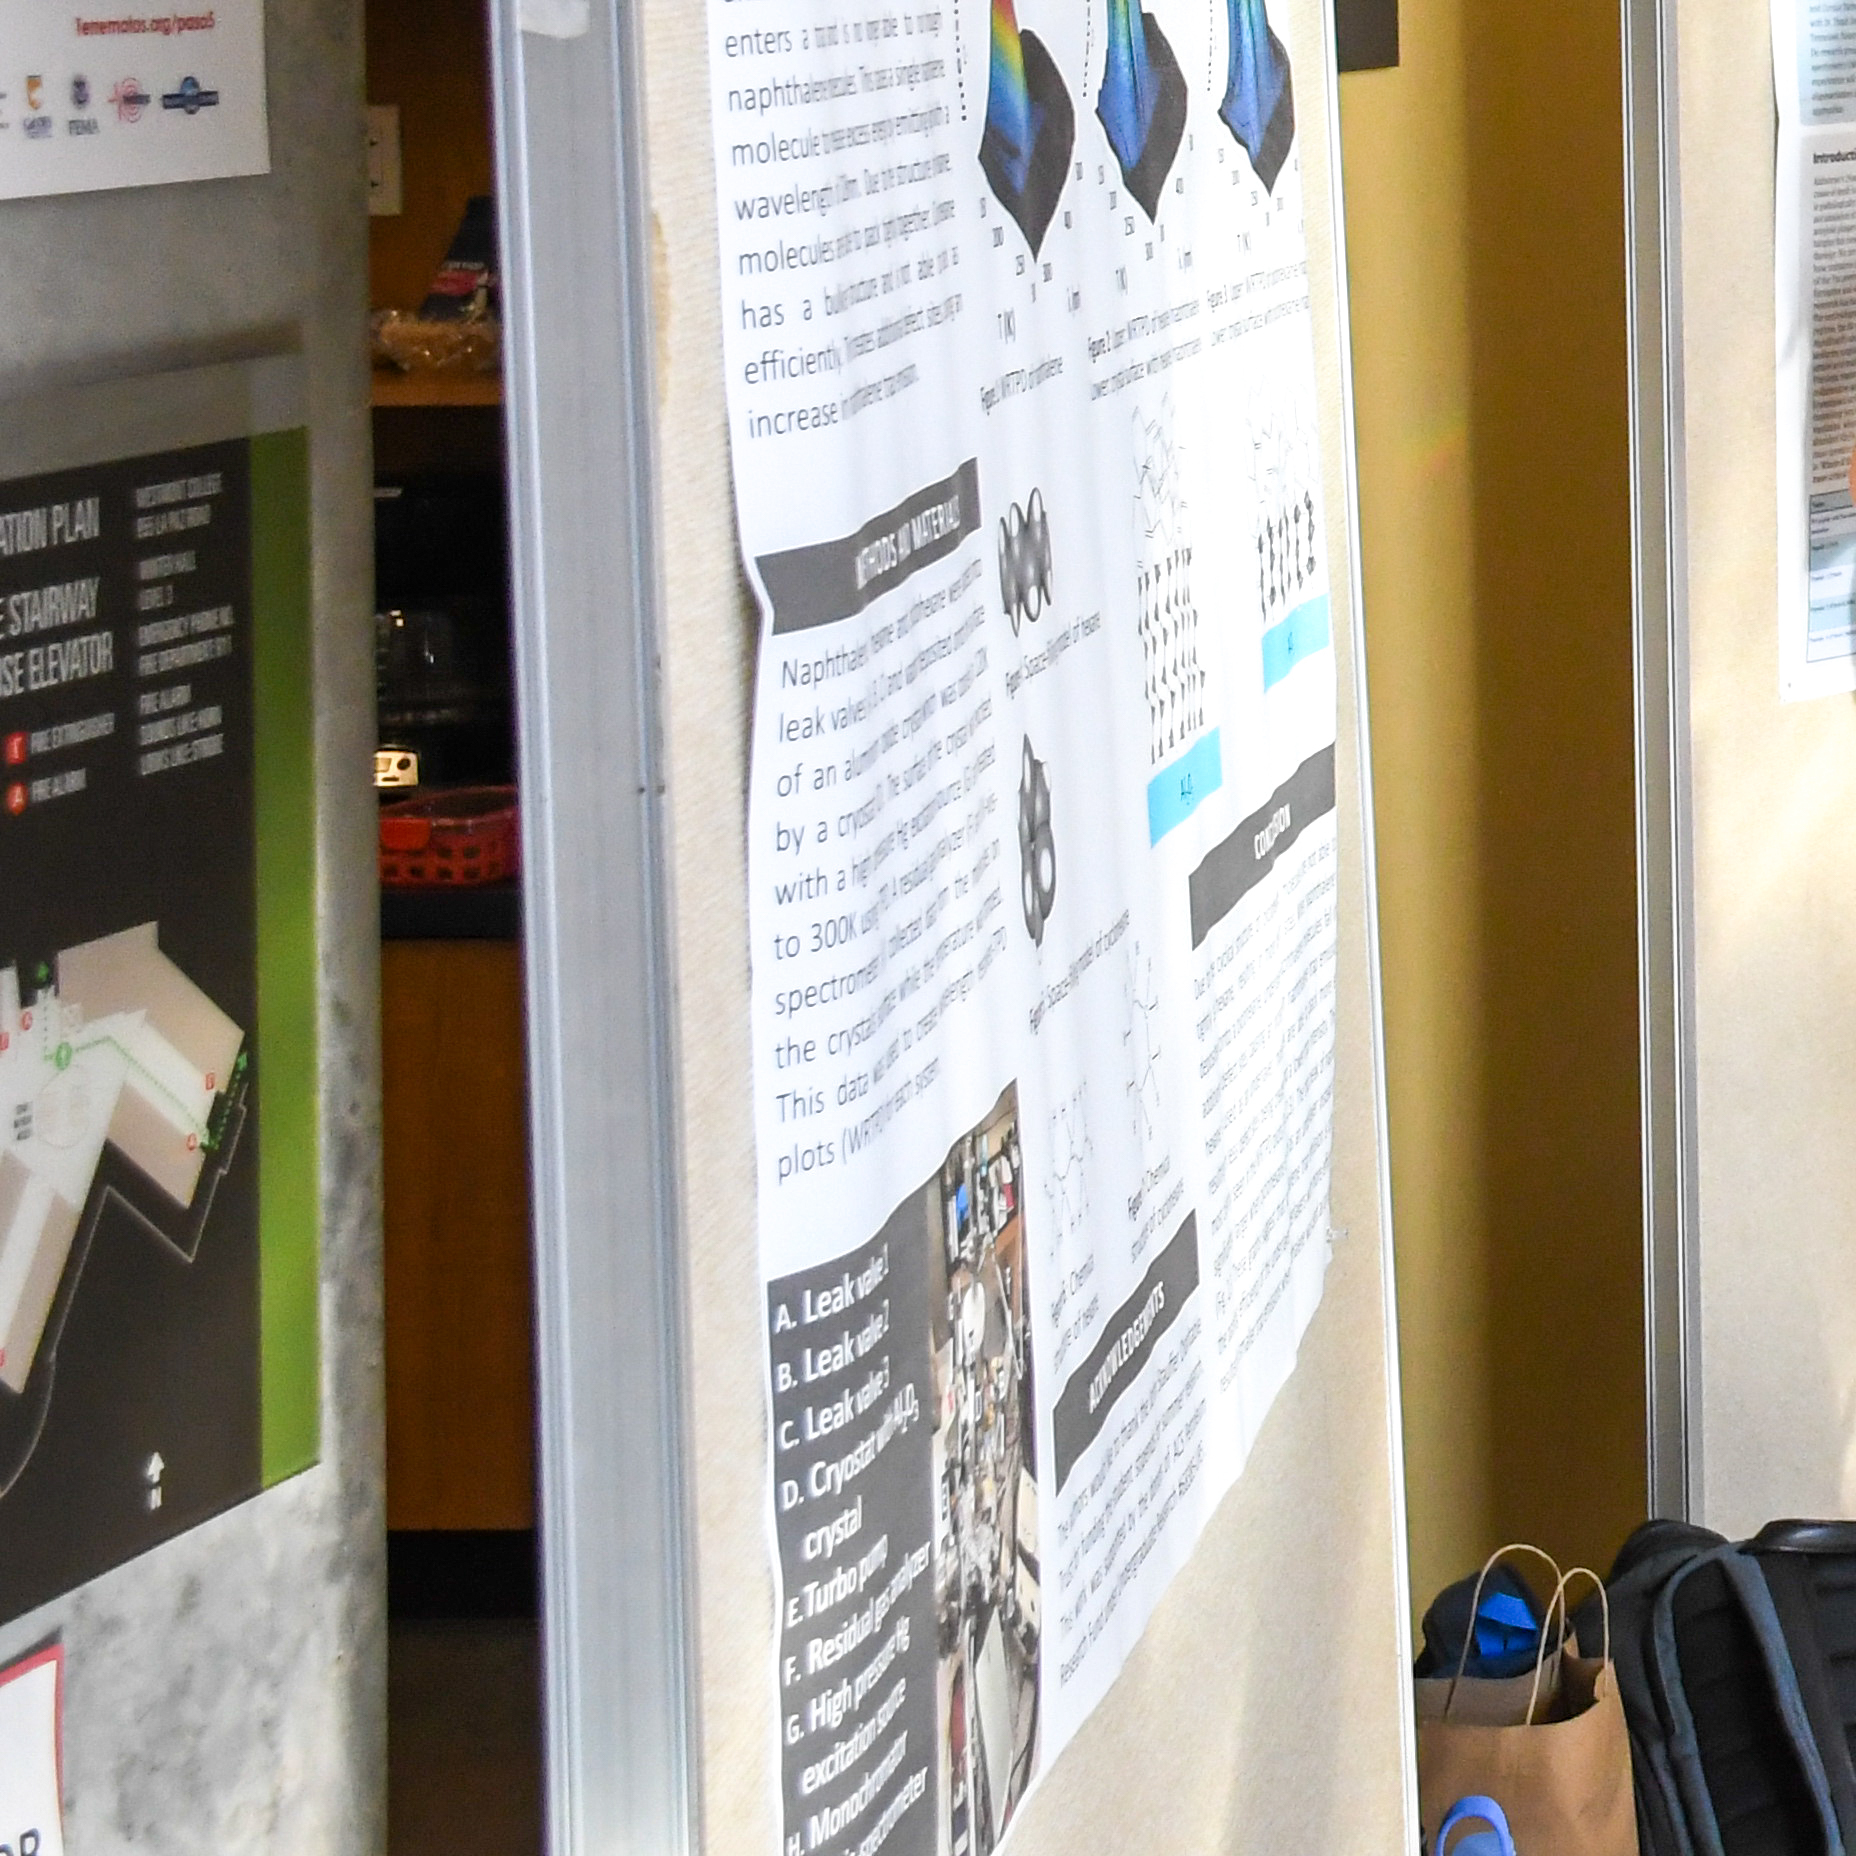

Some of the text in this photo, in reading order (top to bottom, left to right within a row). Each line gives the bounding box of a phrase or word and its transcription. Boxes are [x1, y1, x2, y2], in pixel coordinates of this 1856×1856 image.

[725, 28, 792, 58] enters
[802, 29, 808, 50] a
[741, 299, 813, 329] has a
[748, 401, 838, 438] increase
[52, 496, 100, 546] PLAN
[10, 576, 100, 636] STAIRWAY
[27, 630, 114, 692] ELEVATOR
[779, 705, 826, 743] leak
[777, 763, 837, 798] of an
[776, 821, 828, 855] by a
[775, 868, 846, 905] with a
[774, 911, 857, 960] to 300K
[775, 1036, 816, 1069] the
[776, 1074, 869, 1122] This data
[778, 1142, 835, 1185] plots
[774, 1303, 798, 1335] A.
[803, 1273, 856, 1325] Leak
[776, 1362, 799, 1394] B.
[803, 1330, 856, 1384] Leak
[778, 1420, 800, 1452] C.
[804, 1388, 856, 1442] Leak
[780, 1431, 877, 1512] D. Cryostat
[804, 1494, 863, 1561] crystal
[787, 1596, 804, 1629] E.
[804, 1565, 857, 1618] Turbo
[784, 1656, 802, 1687] F.
[786, 1714, 805, 1747] G.
[810, 1677, 852, 1732] High
[801, 1717, 878, 1797] excitation
[786, 1831, 805, 1856] H.
